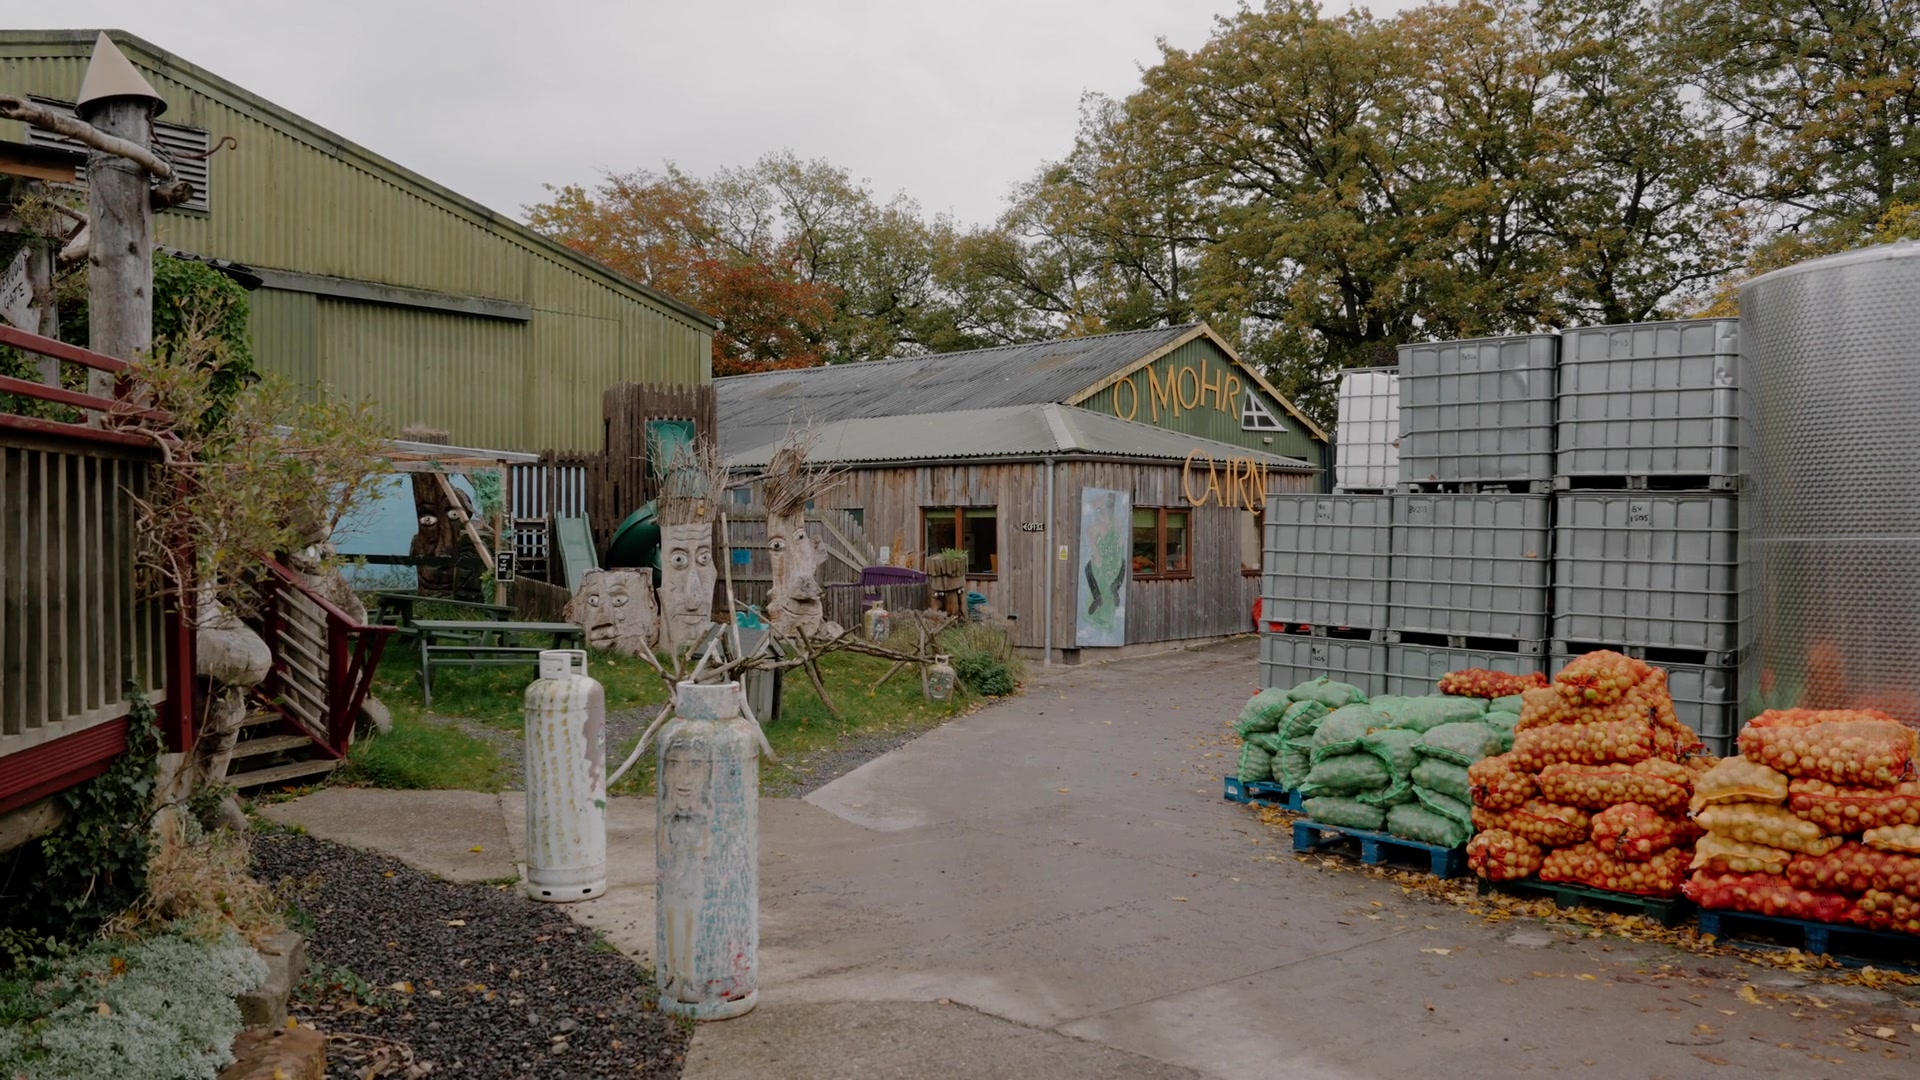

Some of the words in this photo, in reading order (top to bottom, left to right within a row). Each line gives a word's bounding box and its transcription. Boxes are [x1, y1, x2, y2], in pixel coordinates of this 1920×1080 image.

[4, 281, 25, 309] GATE
[1145, 359, 1241, 423] MOHR
[1184, 448, 1268, 515] CAIRN
[1027, 522, 1044, 531] OFFICE
